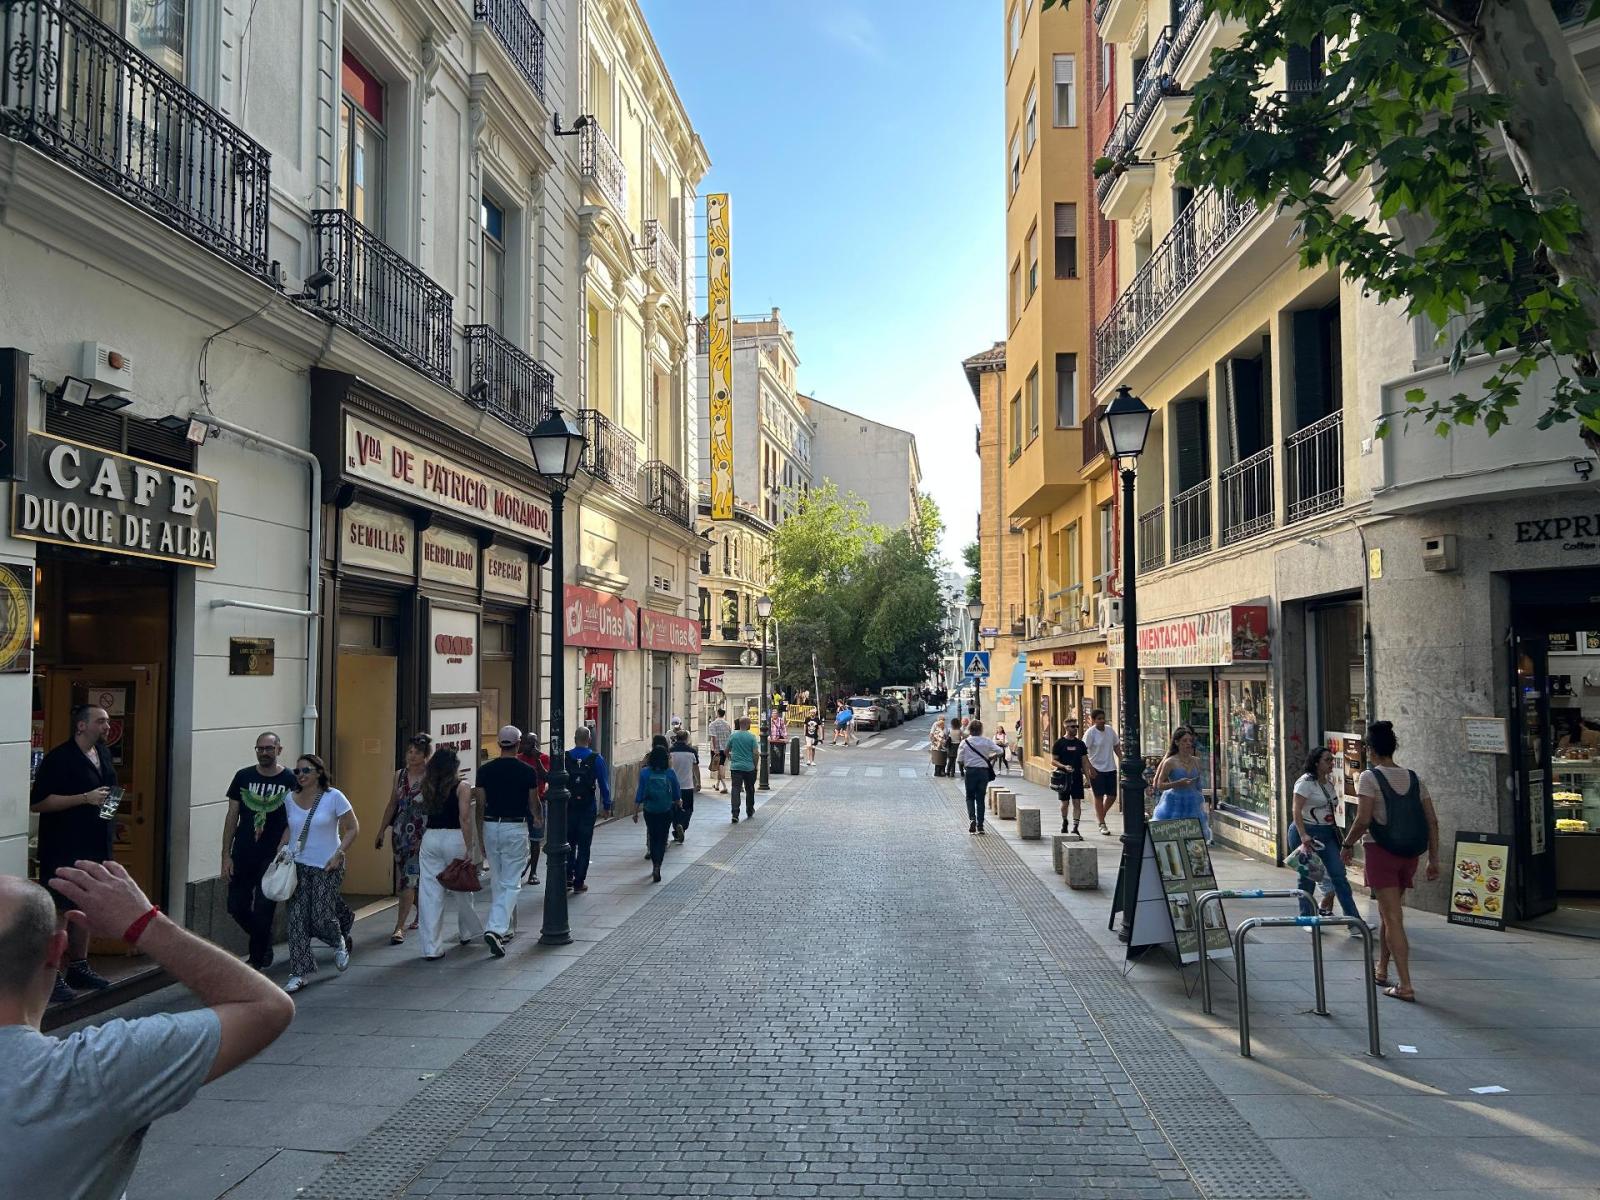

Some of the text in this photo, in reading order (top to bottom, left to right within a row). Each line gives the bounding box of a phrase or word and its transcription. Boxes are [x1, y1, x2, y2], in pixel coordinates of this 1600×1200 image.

[49, 444, 199, 516] CAFE
[392, 445, 415, 484] DE
[423, 459, 487, 511] PATRICIO
[494, 489, 549, 533] MORANDO
[23, 494, 215, 560] DUQUE DE ALBA
[350, 522, 405, 555] SEMILLAS
[424, 542, 473, 571] HERBOLARIO
[1562, 542, 1596, 551] Coffee
[488, 558, 522, 582] ESPECIAS
[599, 607, 622, 638] Uñas
[1137, 621, 1198, 651] IMENTACION
[591, 662, 608, 682] ATM
